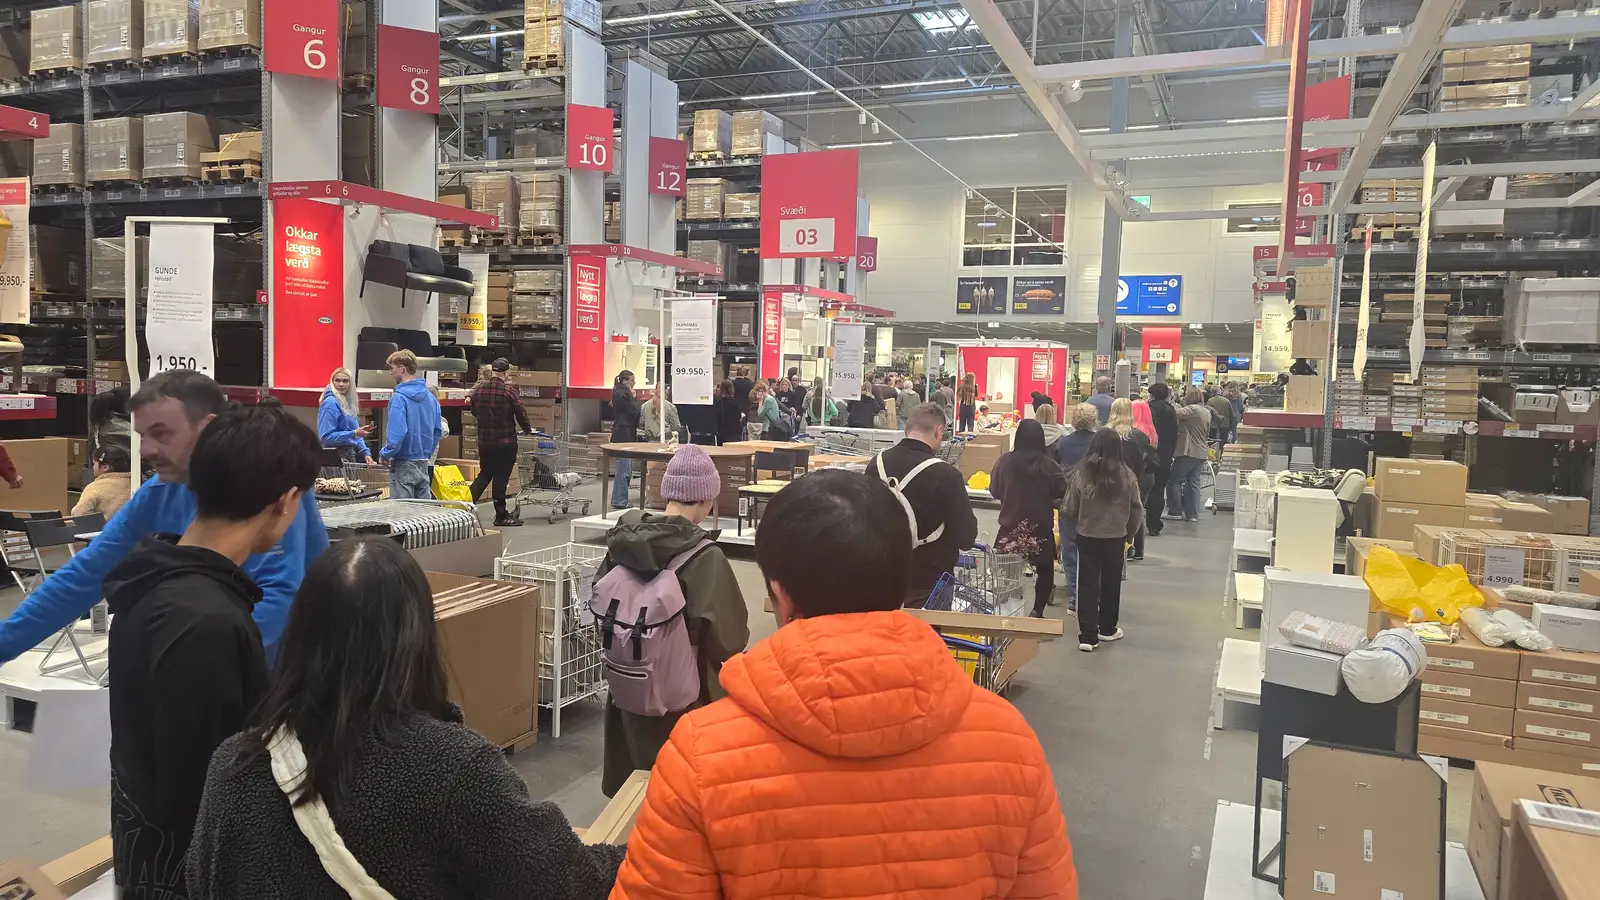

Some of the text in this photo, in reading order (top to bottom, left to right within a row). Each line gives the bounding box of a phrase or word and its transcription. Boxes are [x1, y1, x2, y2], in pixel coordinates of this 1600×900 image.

[293, 24, 326, 36] Gangur
[303, 39, 327, 70] 6
[401, 64, 430, 75] Gangur
[410, 77, 430, 105] 8
[28, 116, 39, 129] 4
[585, 134, 605, 143] Gangur
[579, 143, 606, 166] 10
[657, 170, 680, 191] 12
[325, 185, 348, 195] 6 6
[780, 205, 807, 216] Svæði
[285, 225, 318, 240] Okkar
[796, 228, 818, 246] 03
[285, 240, 322, 256] lægsta
[623, 247, 631, 255] 10
[1260, 248, 1270, 257] 15
[284, 257, 309, 269] verð
[860, 255, 874, 268] 20
[155, 267, 178, 275] GUNDE
[580, 269, 595, 282] Nýtt
[579, 293, 598, 305] lægra
[578, 314, 594, 324] verð
[676, 368, 708, 376] 99.950,-
[1486, 575, 1520, 584] 4.990,-
